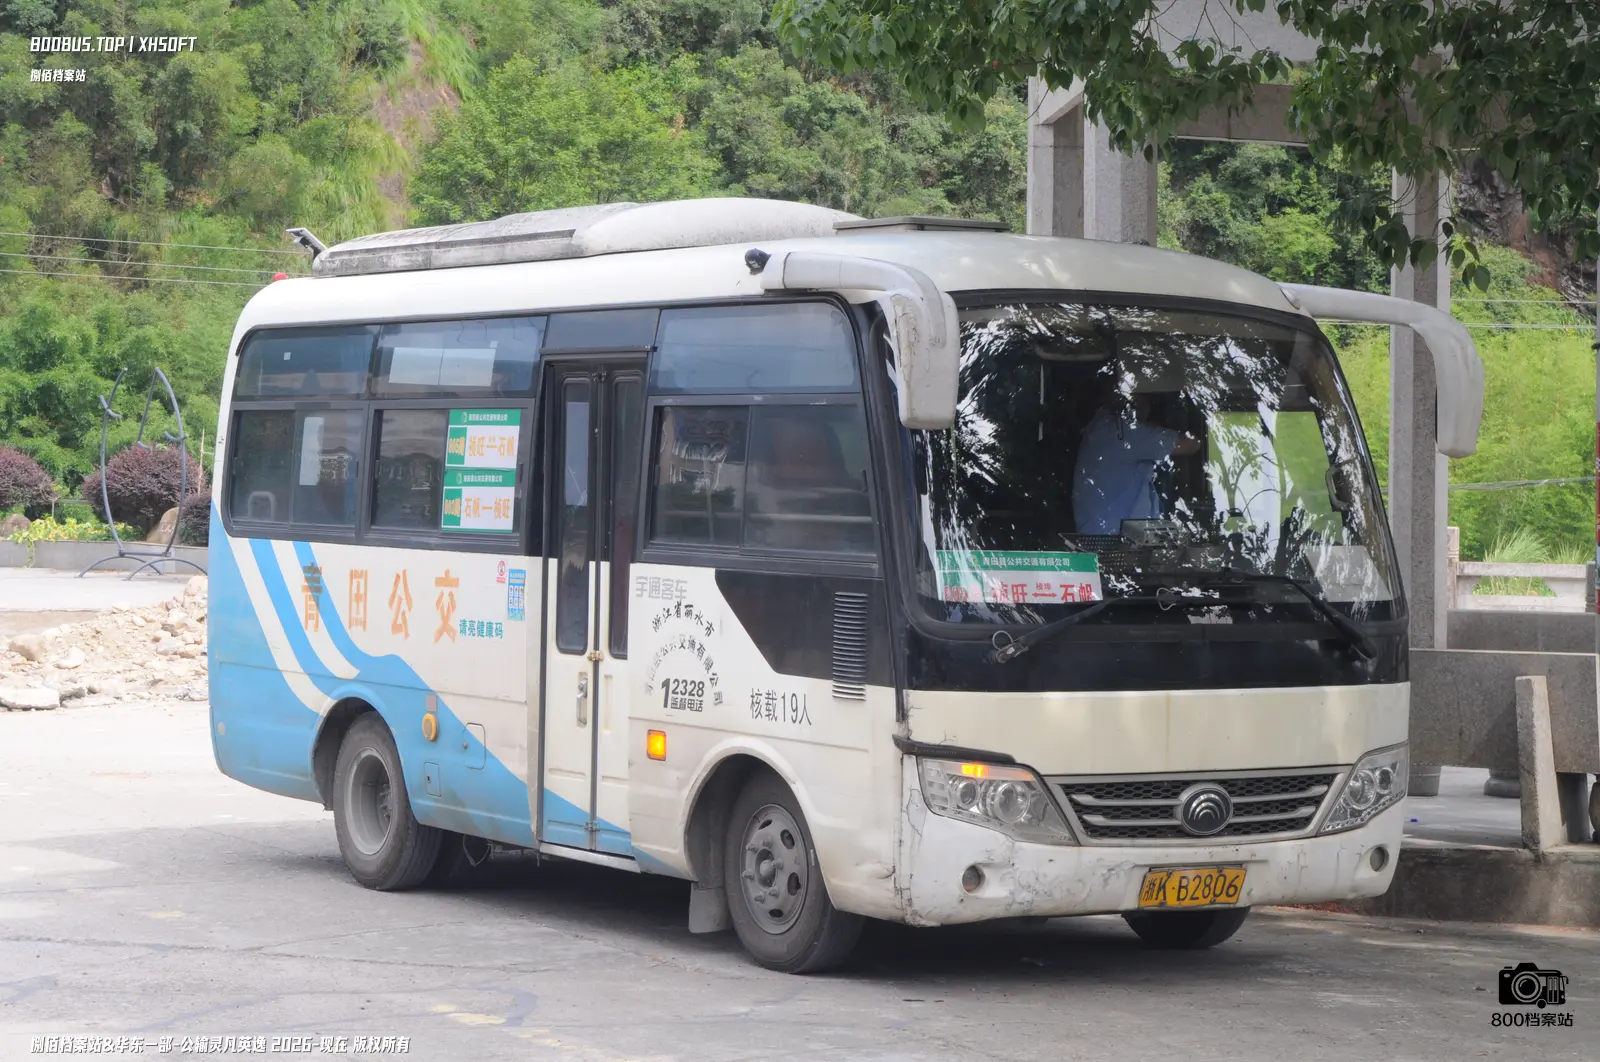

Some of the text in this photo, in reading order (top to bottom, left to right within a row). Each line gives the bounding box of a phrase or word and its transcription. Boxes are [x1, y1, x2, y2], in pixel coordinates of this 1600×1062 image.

[983, 556, 1070, 567] 青田县公共交通有限公司
[635, 575, 688, 600] 宇通客车
[301, 561, 460, 645] 青田公交
[458, 618, 504, 640] 请亮健康码
[652, 601, 715, 637] 浙江省丽水市
[660, 677, 706, 709] 12328
[670, 696, 704, 712] 监督电话
[749, 687, 812, 727] 核载19人
